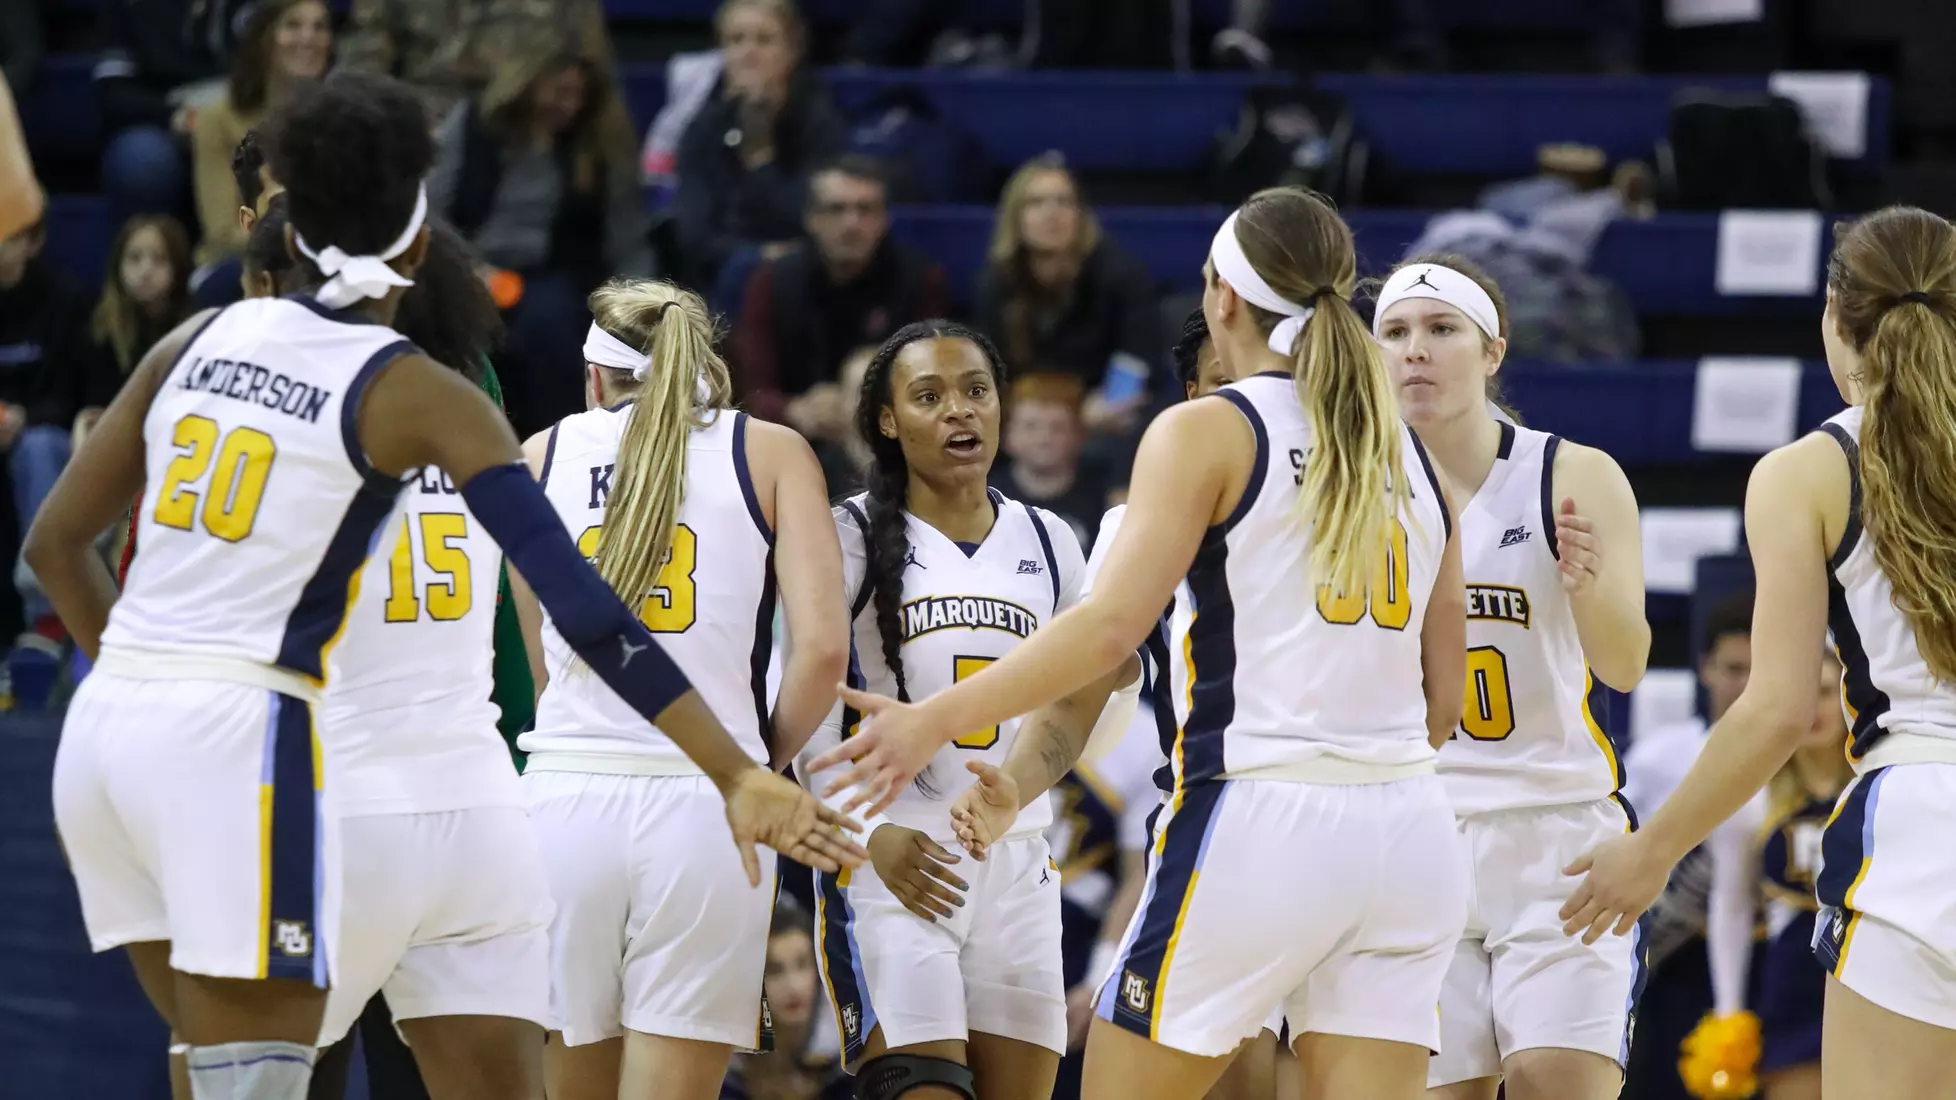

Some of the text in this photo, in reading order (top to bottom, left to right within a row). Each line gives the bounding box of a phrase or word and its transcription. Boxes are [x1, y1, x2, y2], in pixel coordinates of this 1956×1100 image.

[153, 413, 278, 543] 20
[1500, 532, 1533, 545] EAST
[1503, 526, 1526, 537] BIG
[385, 512, 473, 623] 15
[1017, 566, 1044, 574] EAST
[1019, 559, 1037, 568] BIG
[906, 597, 1038, 638] MARQUETTE
[1124, 972, 1149, 1011] MU
[842, 1005, 858, 1036] MU
